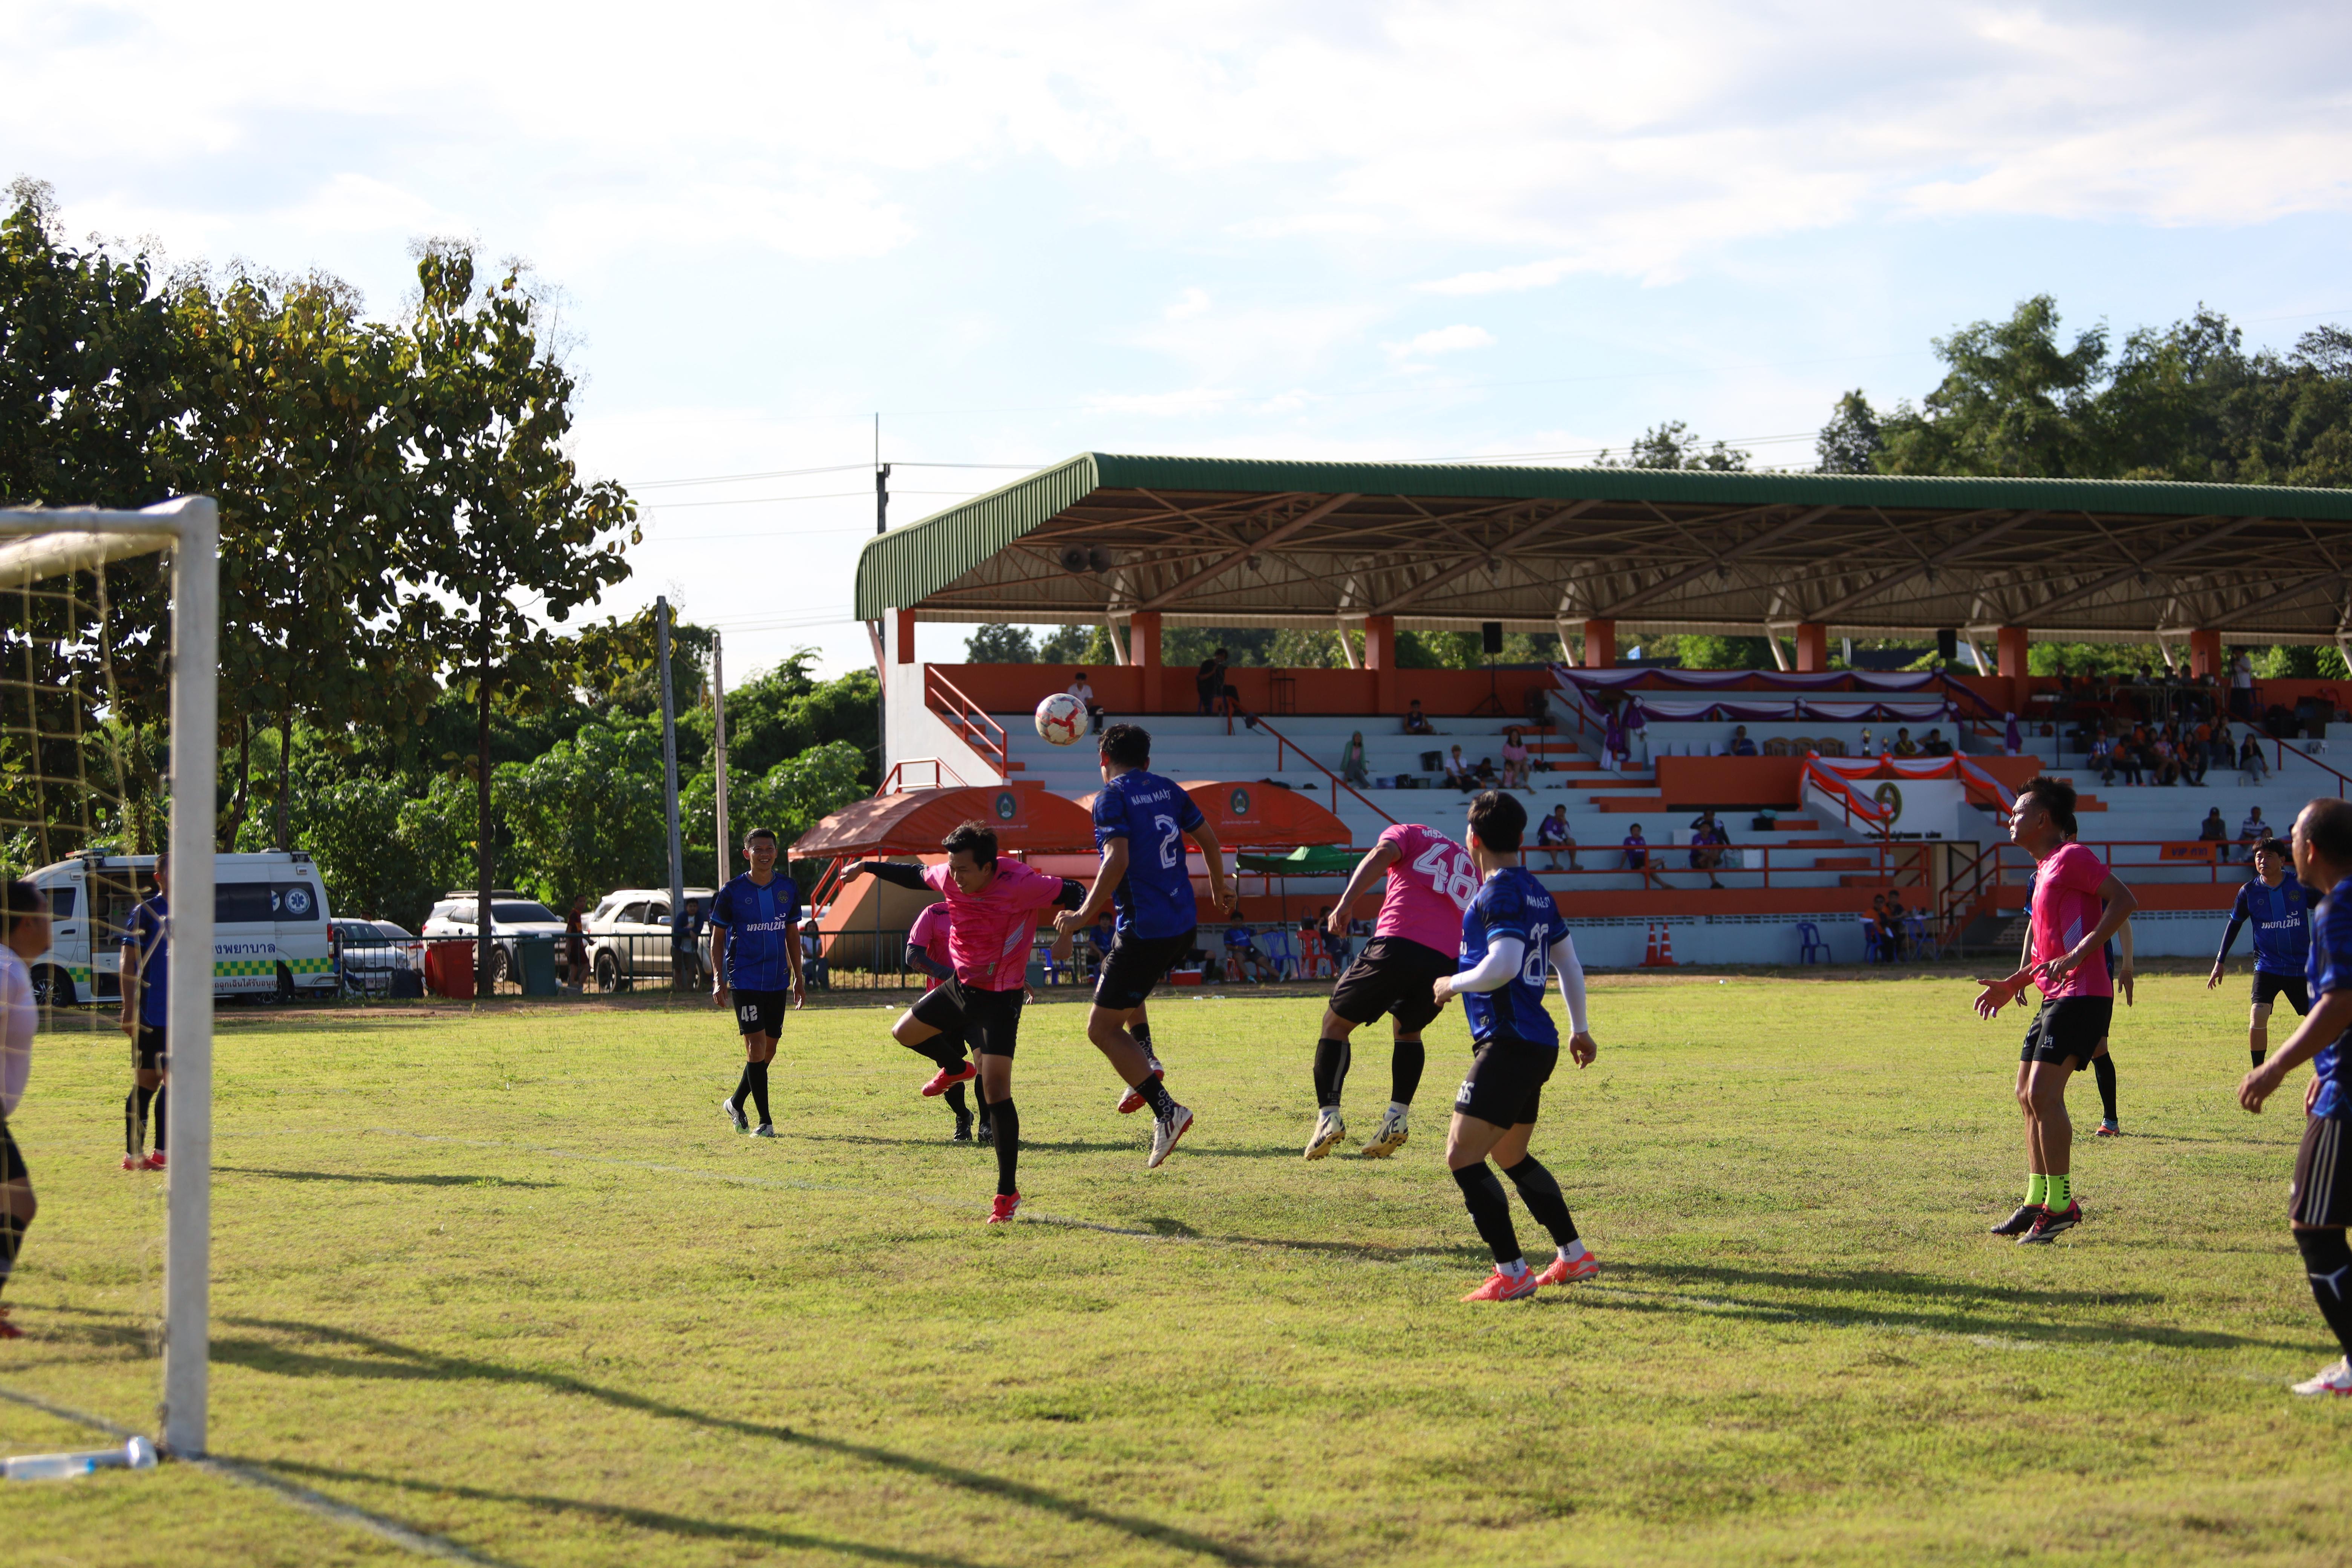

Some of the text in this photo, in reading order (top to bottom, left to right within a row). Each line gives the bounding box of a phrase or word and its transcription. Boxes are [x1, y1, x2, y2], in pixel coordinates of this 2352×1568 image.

[1155, 814, 1179, 869] 2
[2171, 847, 2188, 856] VIP
[1412, 842, 1480, 911] 48
[741, 1004, 758, 1022] 42
